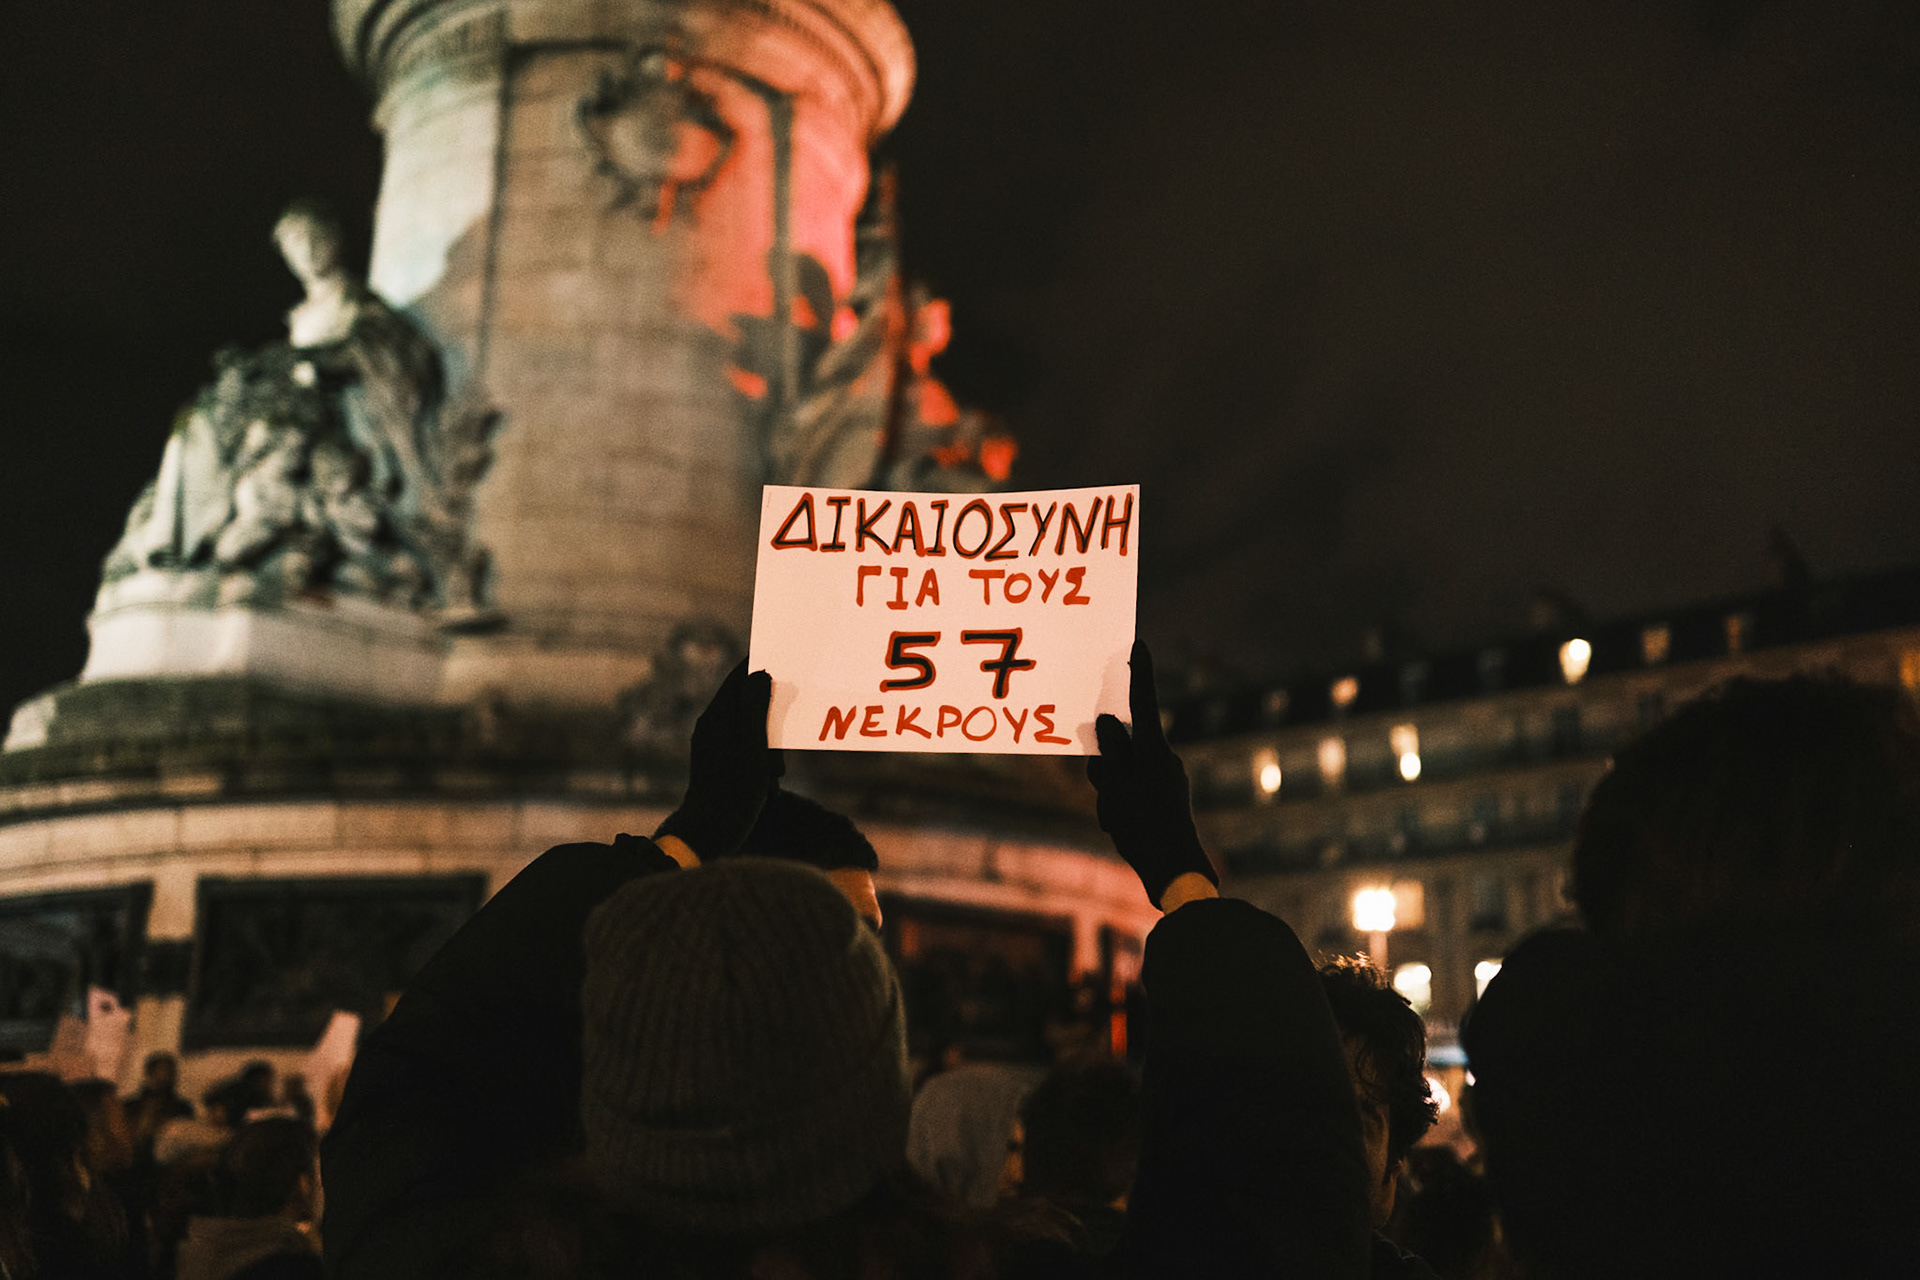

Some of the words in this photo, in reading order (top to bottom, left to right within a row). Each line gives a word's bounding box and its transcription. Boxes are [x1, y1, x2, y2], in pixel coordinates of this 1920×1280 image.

[771, 492, 1133, 561] ΔΙΚΑΙΟΣΥΝΗ
[856, 565, 940, 610] ΓΙΑ
[969, 566, 1091, 606] ΤΟΥΣ
[879, 627, 1037, 699] 57
[818, 704, 1072, 745] ΝΕΚΡΟΥΣ
